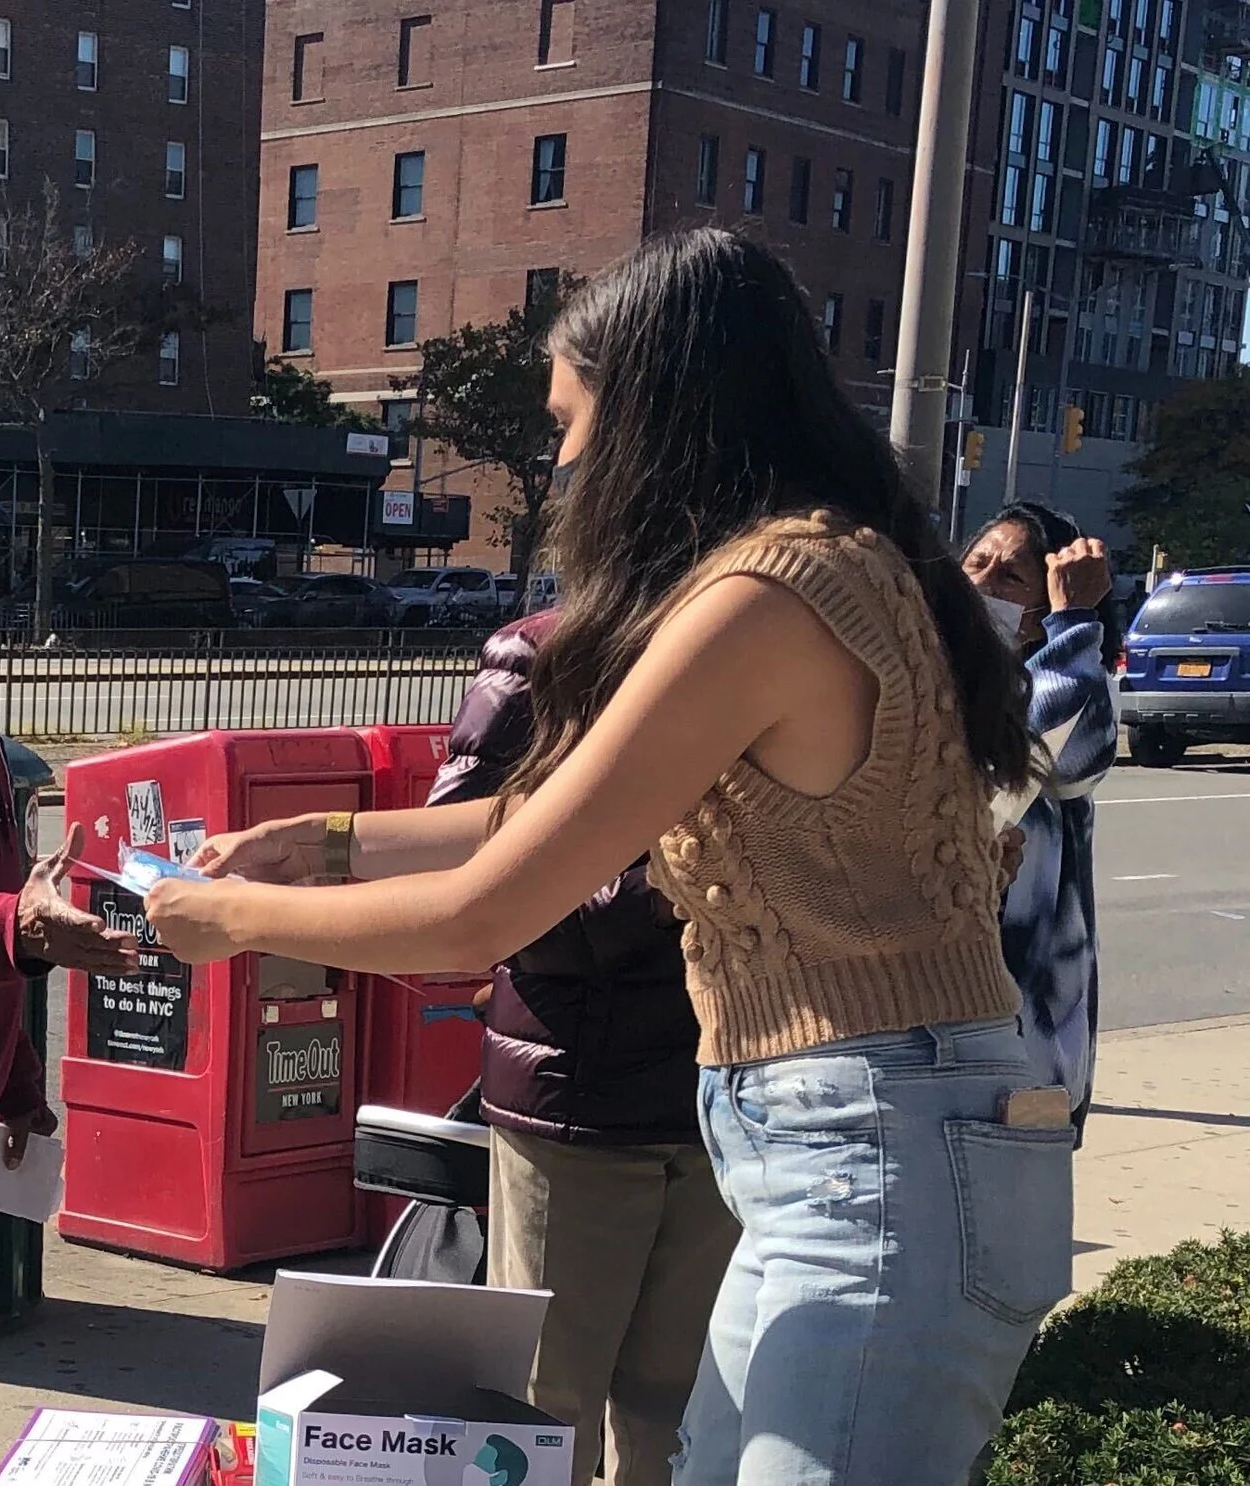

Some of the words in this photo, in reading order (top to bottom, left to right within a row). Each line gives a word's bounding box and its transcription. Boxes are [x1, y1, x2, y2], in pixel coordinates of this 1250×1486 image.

[385, 502, 411, 518] OPEN
[138, 954, 159, 968] YORK
[95, 975, 116, 991] The
[119, 978, 145, 994] best
[147, 981, 182, 1001] things
[103, 995, 115, 1010] to
[118, 997, 134, 1012] do
[149, 1001, 174, 1017] NYC
[281, 1093, 299, 1108] NEW
[301, 1091, 322, 1106] YORK
[303, 1425, 372, 1453] Face
[381, 1430, 458, 1457] Mask
[303, 1456, 348, 1469] Disposable
[349, 1459, 368, 1468] Face
[370, 1460, 391, 1470] Mask
